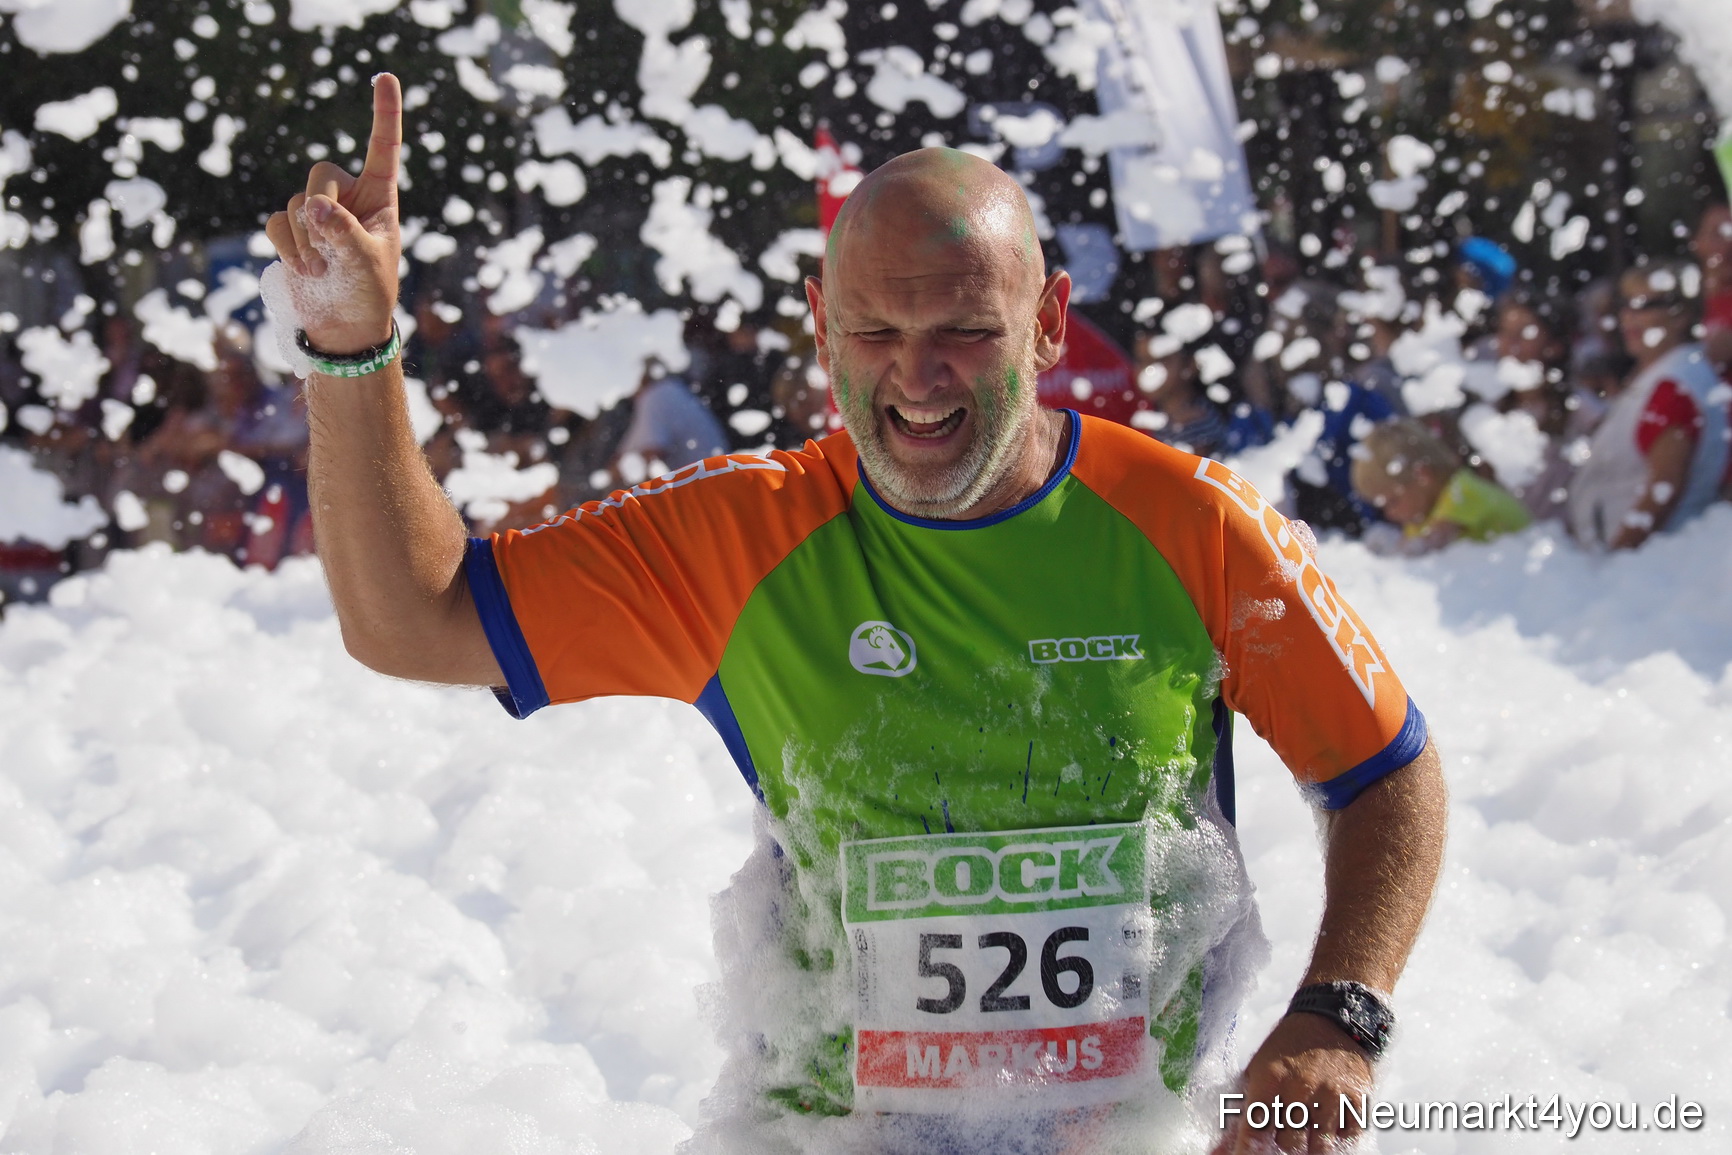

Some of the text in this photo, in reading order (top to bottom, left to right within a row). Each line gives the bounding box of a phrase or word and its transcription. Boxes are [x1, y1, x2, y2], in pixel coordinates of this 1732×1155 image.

[1197, 458, 1384, 708] BOCK
[1029, 636, 1142, 662] BOCK
[869, 840, 1121, 908] BOCK
[916, 926, 1094, 1014] 526
[906, 1035, 1105, 1079] MARKUS
